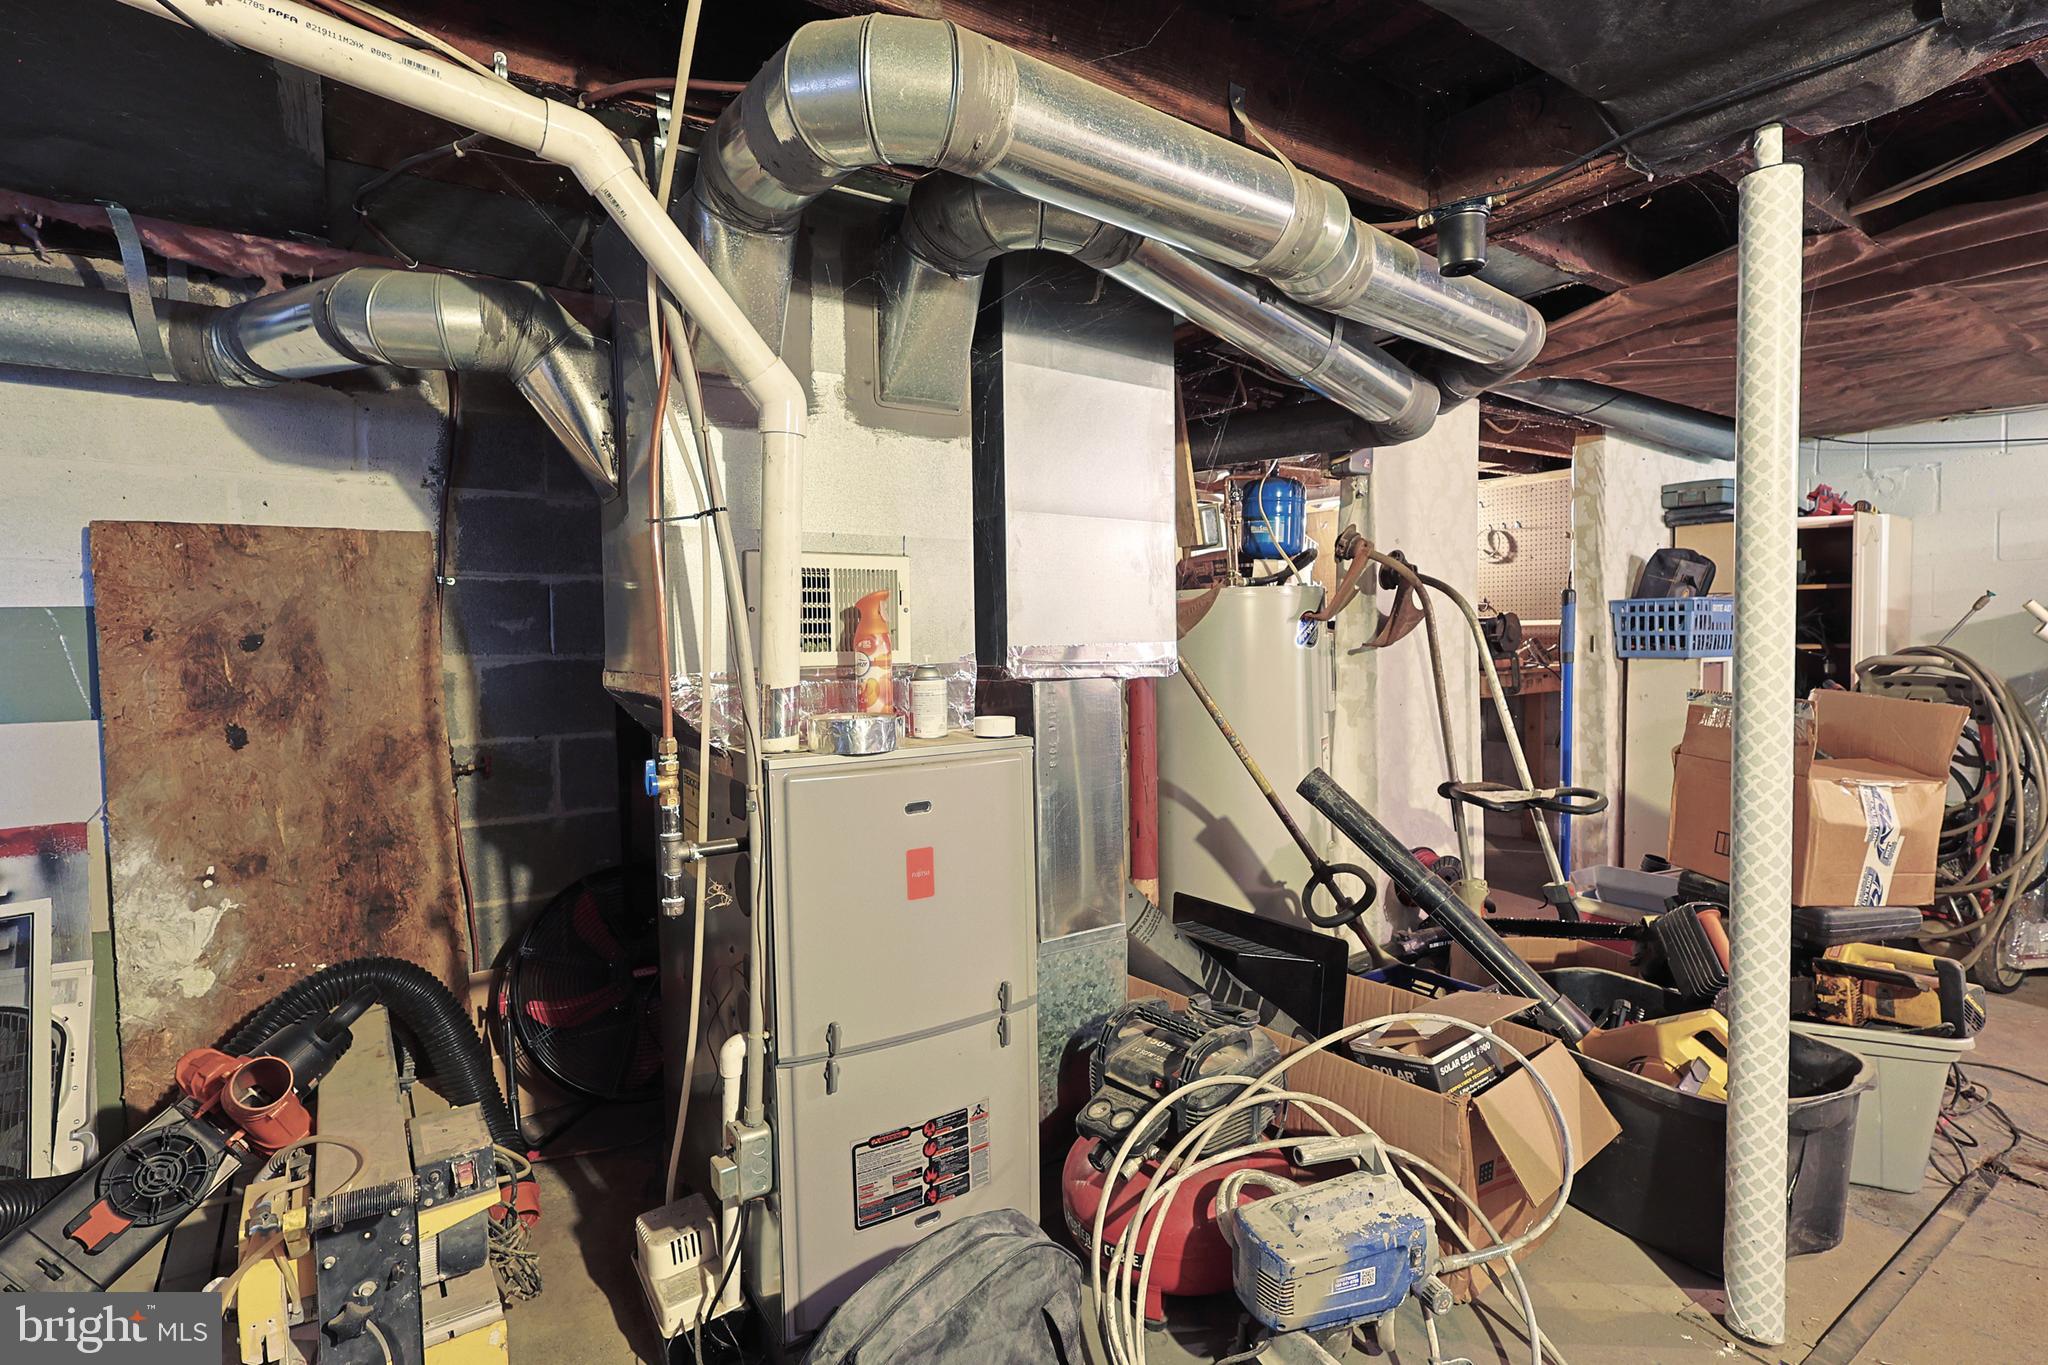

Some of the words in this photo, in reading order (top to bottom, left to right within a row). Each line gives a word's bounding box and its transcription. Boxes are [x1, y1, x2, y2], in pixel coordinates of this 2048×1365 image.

[268, 8, 298, 24] PPFA
[1440, 1058, 1460, 1076] SOLAR
[1460, 1050, 1476, 1065] SEAL
